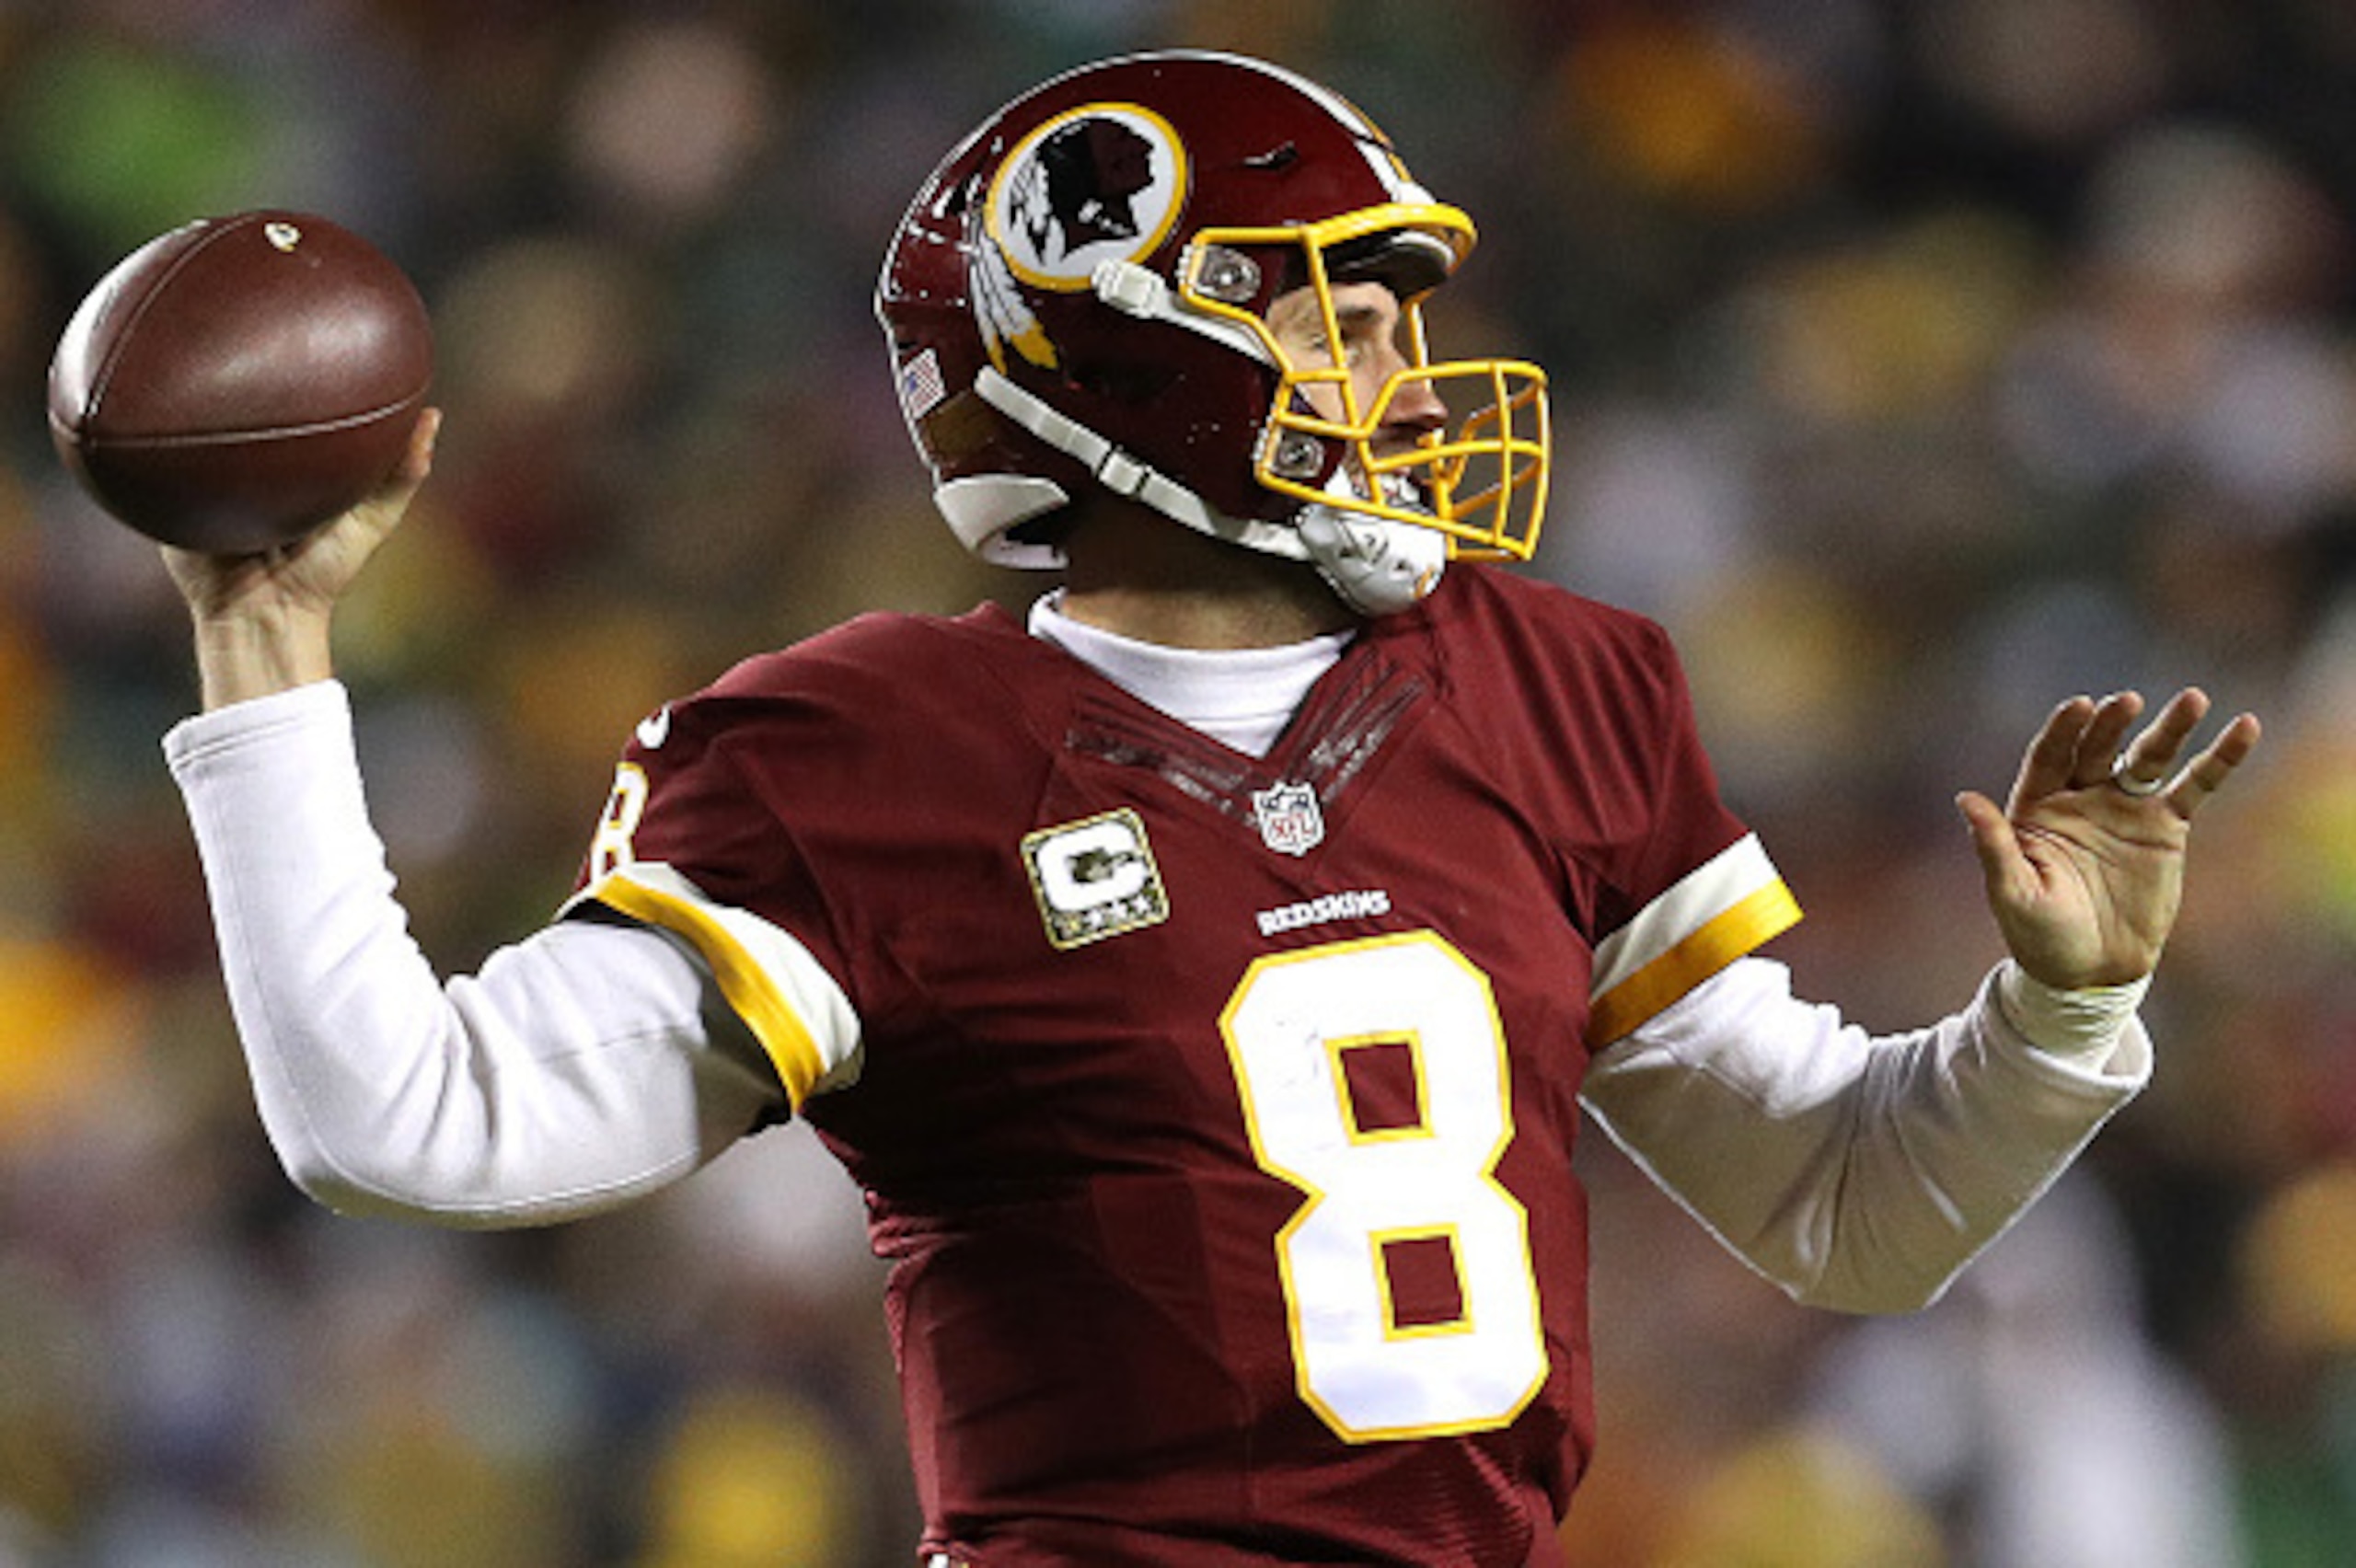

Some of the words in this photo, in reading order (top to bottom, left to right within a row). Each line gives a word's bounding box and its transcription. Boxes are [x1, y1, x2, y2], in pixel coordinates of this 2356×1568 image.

[1036, 820, 1148, 913] C
[1256, 890, 1392, 937] REDSKINS
[1218, 928, 1551, 1444] 8
